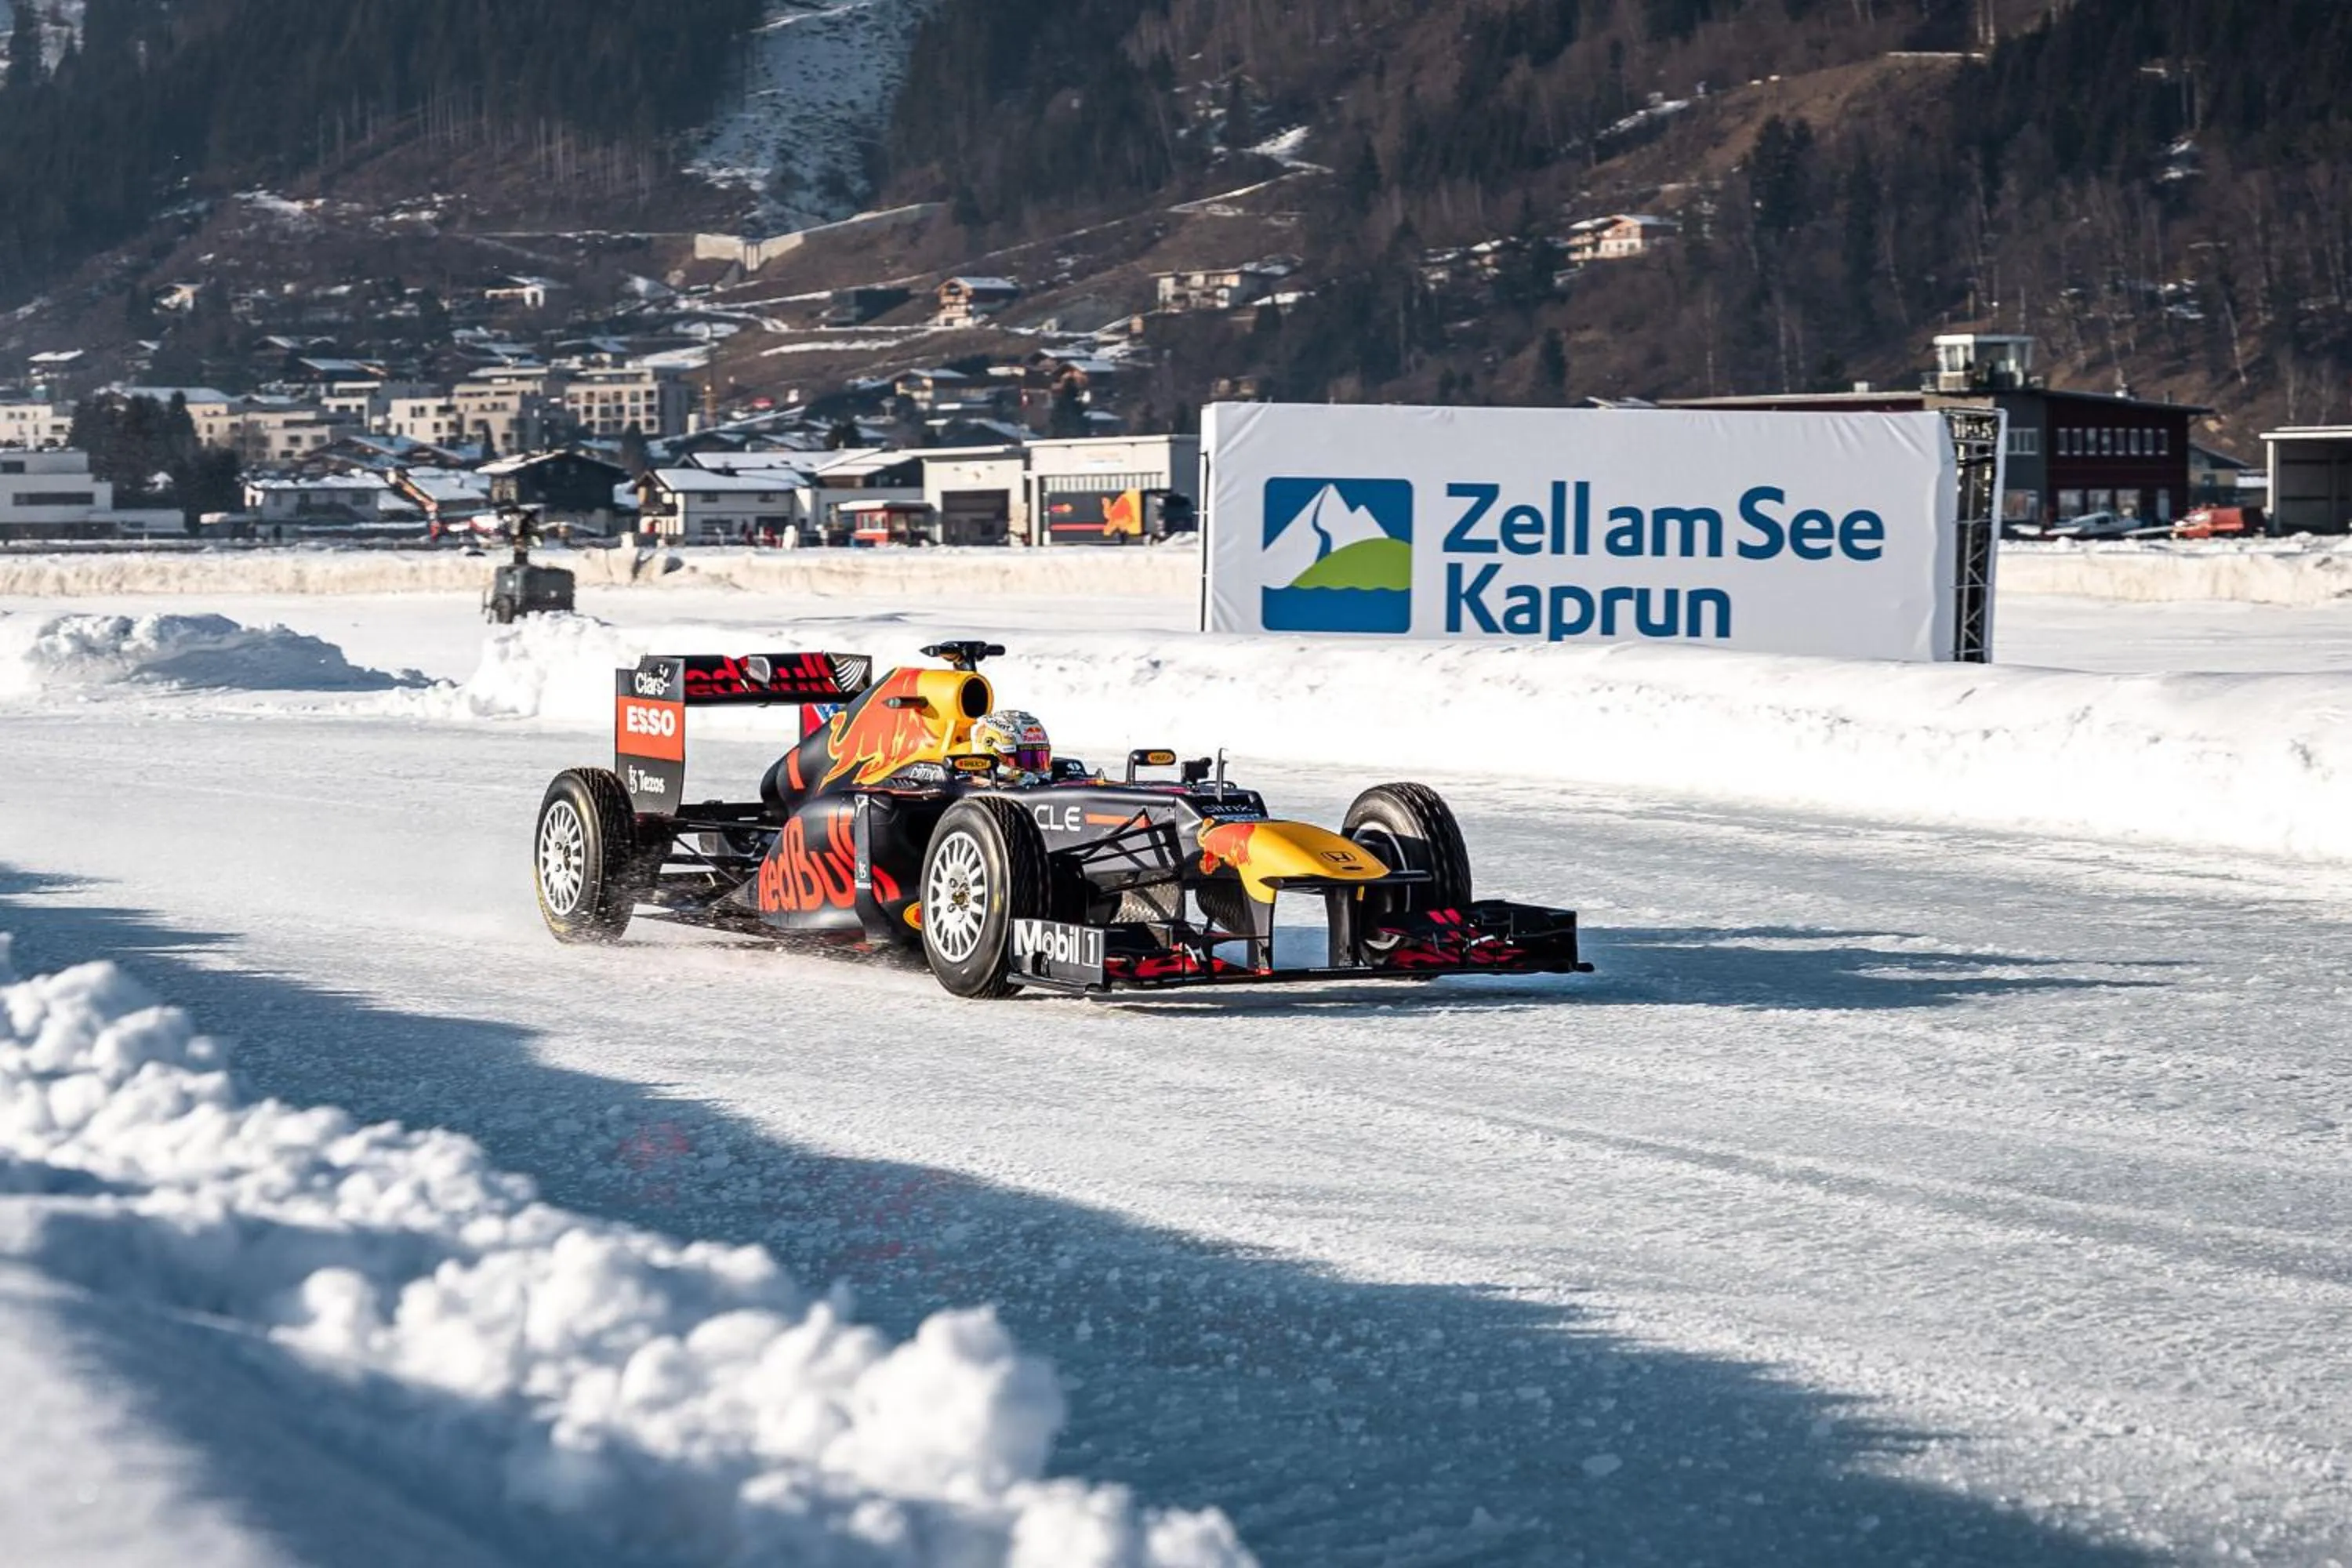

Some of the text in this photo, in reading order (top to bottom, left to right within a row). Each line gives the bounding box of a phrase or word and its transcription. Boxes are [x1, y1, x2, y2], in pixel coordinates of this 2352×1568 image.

[1442, 481, 1885, 560] Zell am See
[1446, 563, 1731, 641] Kaprun
[626, 706, 676, 738] ESSO
[639, 769, 665, 793] Tezos
[1014, 920, 1097, 965] Mobil 1
